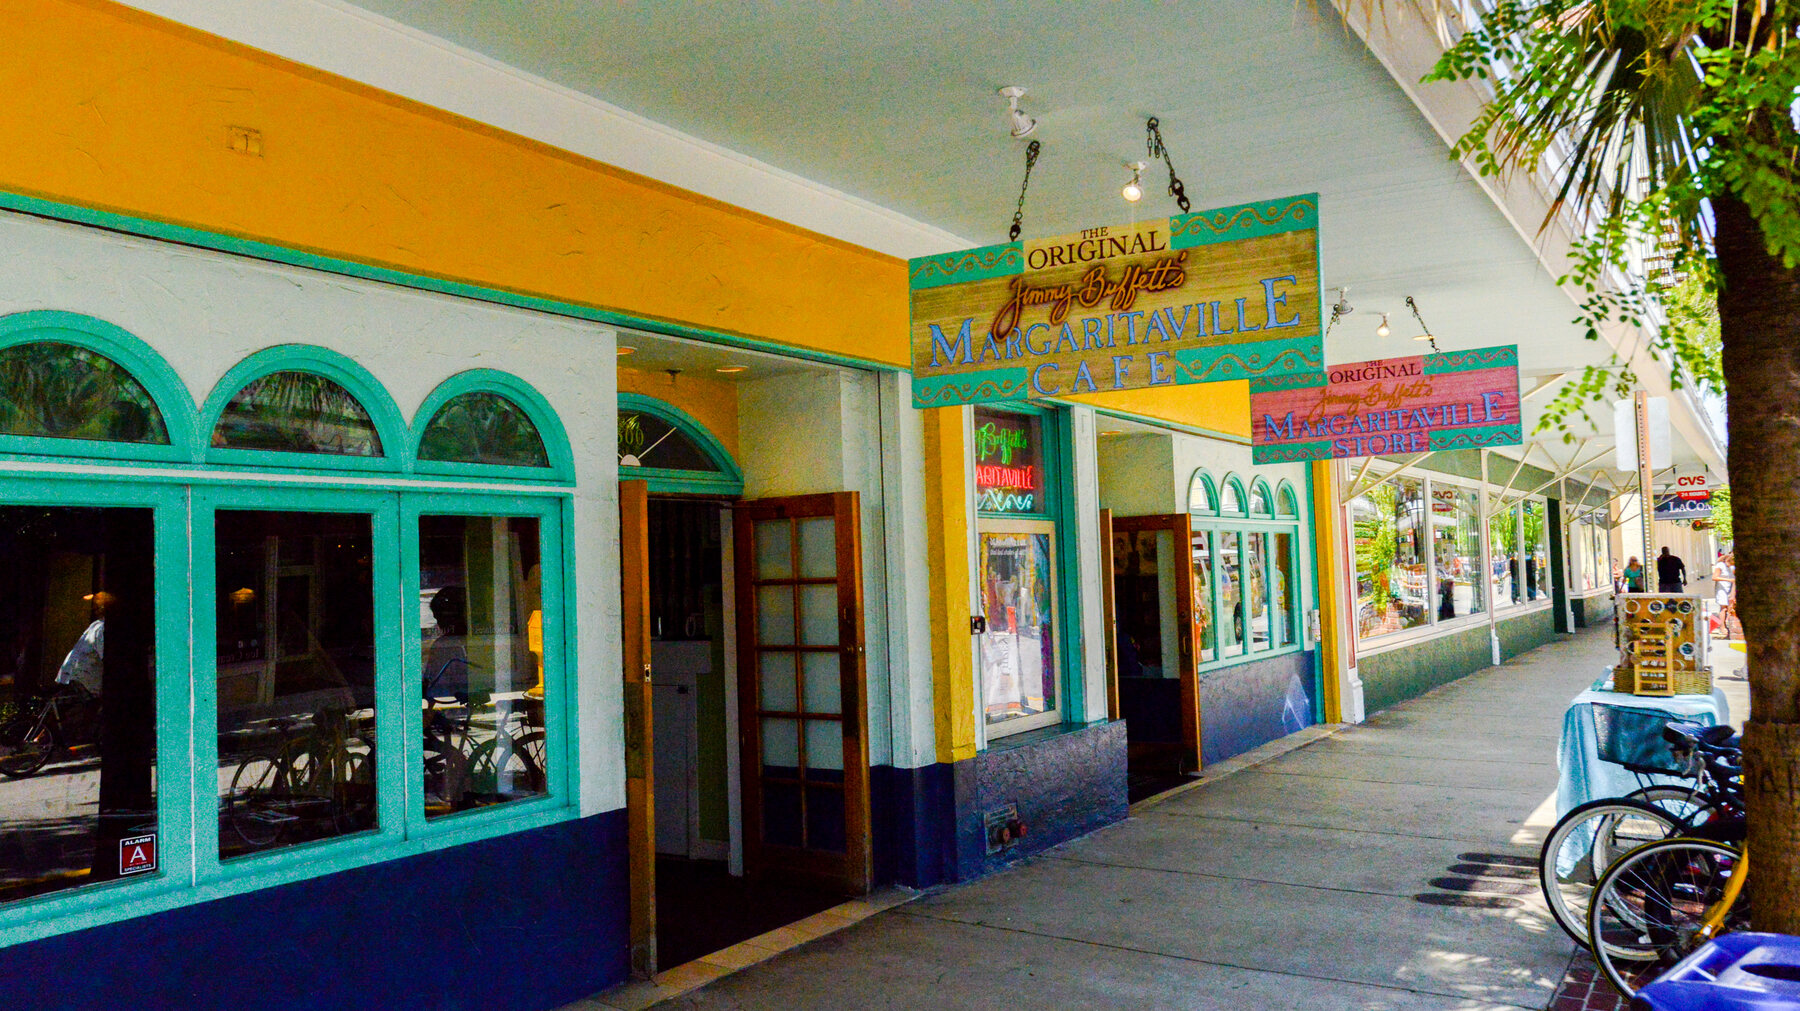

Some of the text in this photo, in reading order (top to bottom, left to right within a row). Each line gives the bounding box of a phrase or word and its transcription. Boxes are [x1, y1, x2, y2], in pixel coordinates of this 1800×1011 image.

[1080, 226, 1109, 240] THE
[1028, 231, 1167, 270] ORIGINAL
[992, 274, 1073, 342] Jimmy
[928, 274, 1301, 368] MARGARITAVILLE
[1032, 351, 1172, 397] CAFE
[1329, 363, 1421, 384] ORIGINAL
[1365, 360, 1383, 368] THE
[1263, 391, 1507, 442] MARGARITAVILLE
[1308, 388, 1361, 423] Jimmy
[1333, 431, 1425, 458] STORE
[976, 465, 1034, 489] ARITAVILLE
[1678, 475, 1706, 487] CVS
[125, 837, 151, 845] ALARM
[130, 846, 147, 863] A
